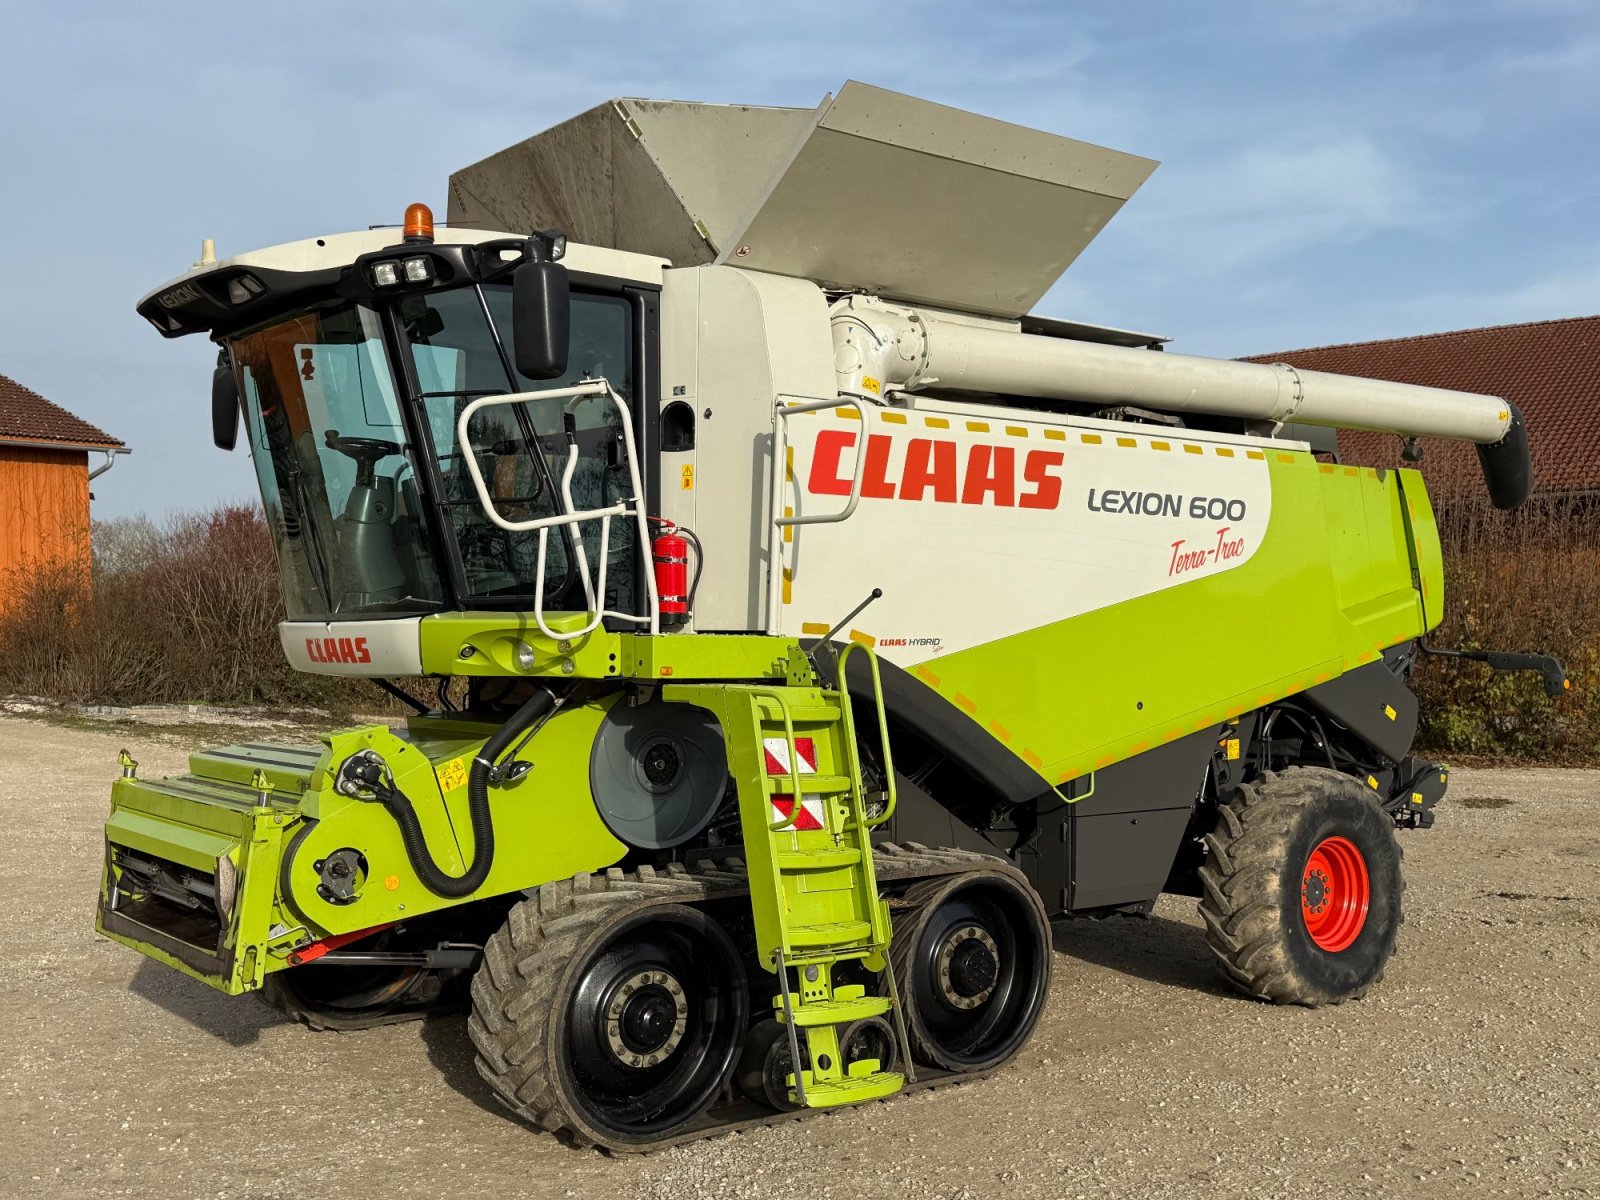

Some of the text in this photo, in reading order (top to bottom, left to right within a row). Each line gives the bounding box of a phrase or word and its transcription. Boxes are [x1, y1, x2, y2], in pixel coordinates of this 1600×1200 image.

[158, 284, 200, 308] LEXION
[808, 429, 1065, 510] CLAAS
[1087, 488, 1246, 521] LEXION 600
[1168, 527, 1244, 577] Terra-Trac
[305, 637, 372, 663] CLAAS
[879, 638, 941, 647] CLAAS HYBRID
